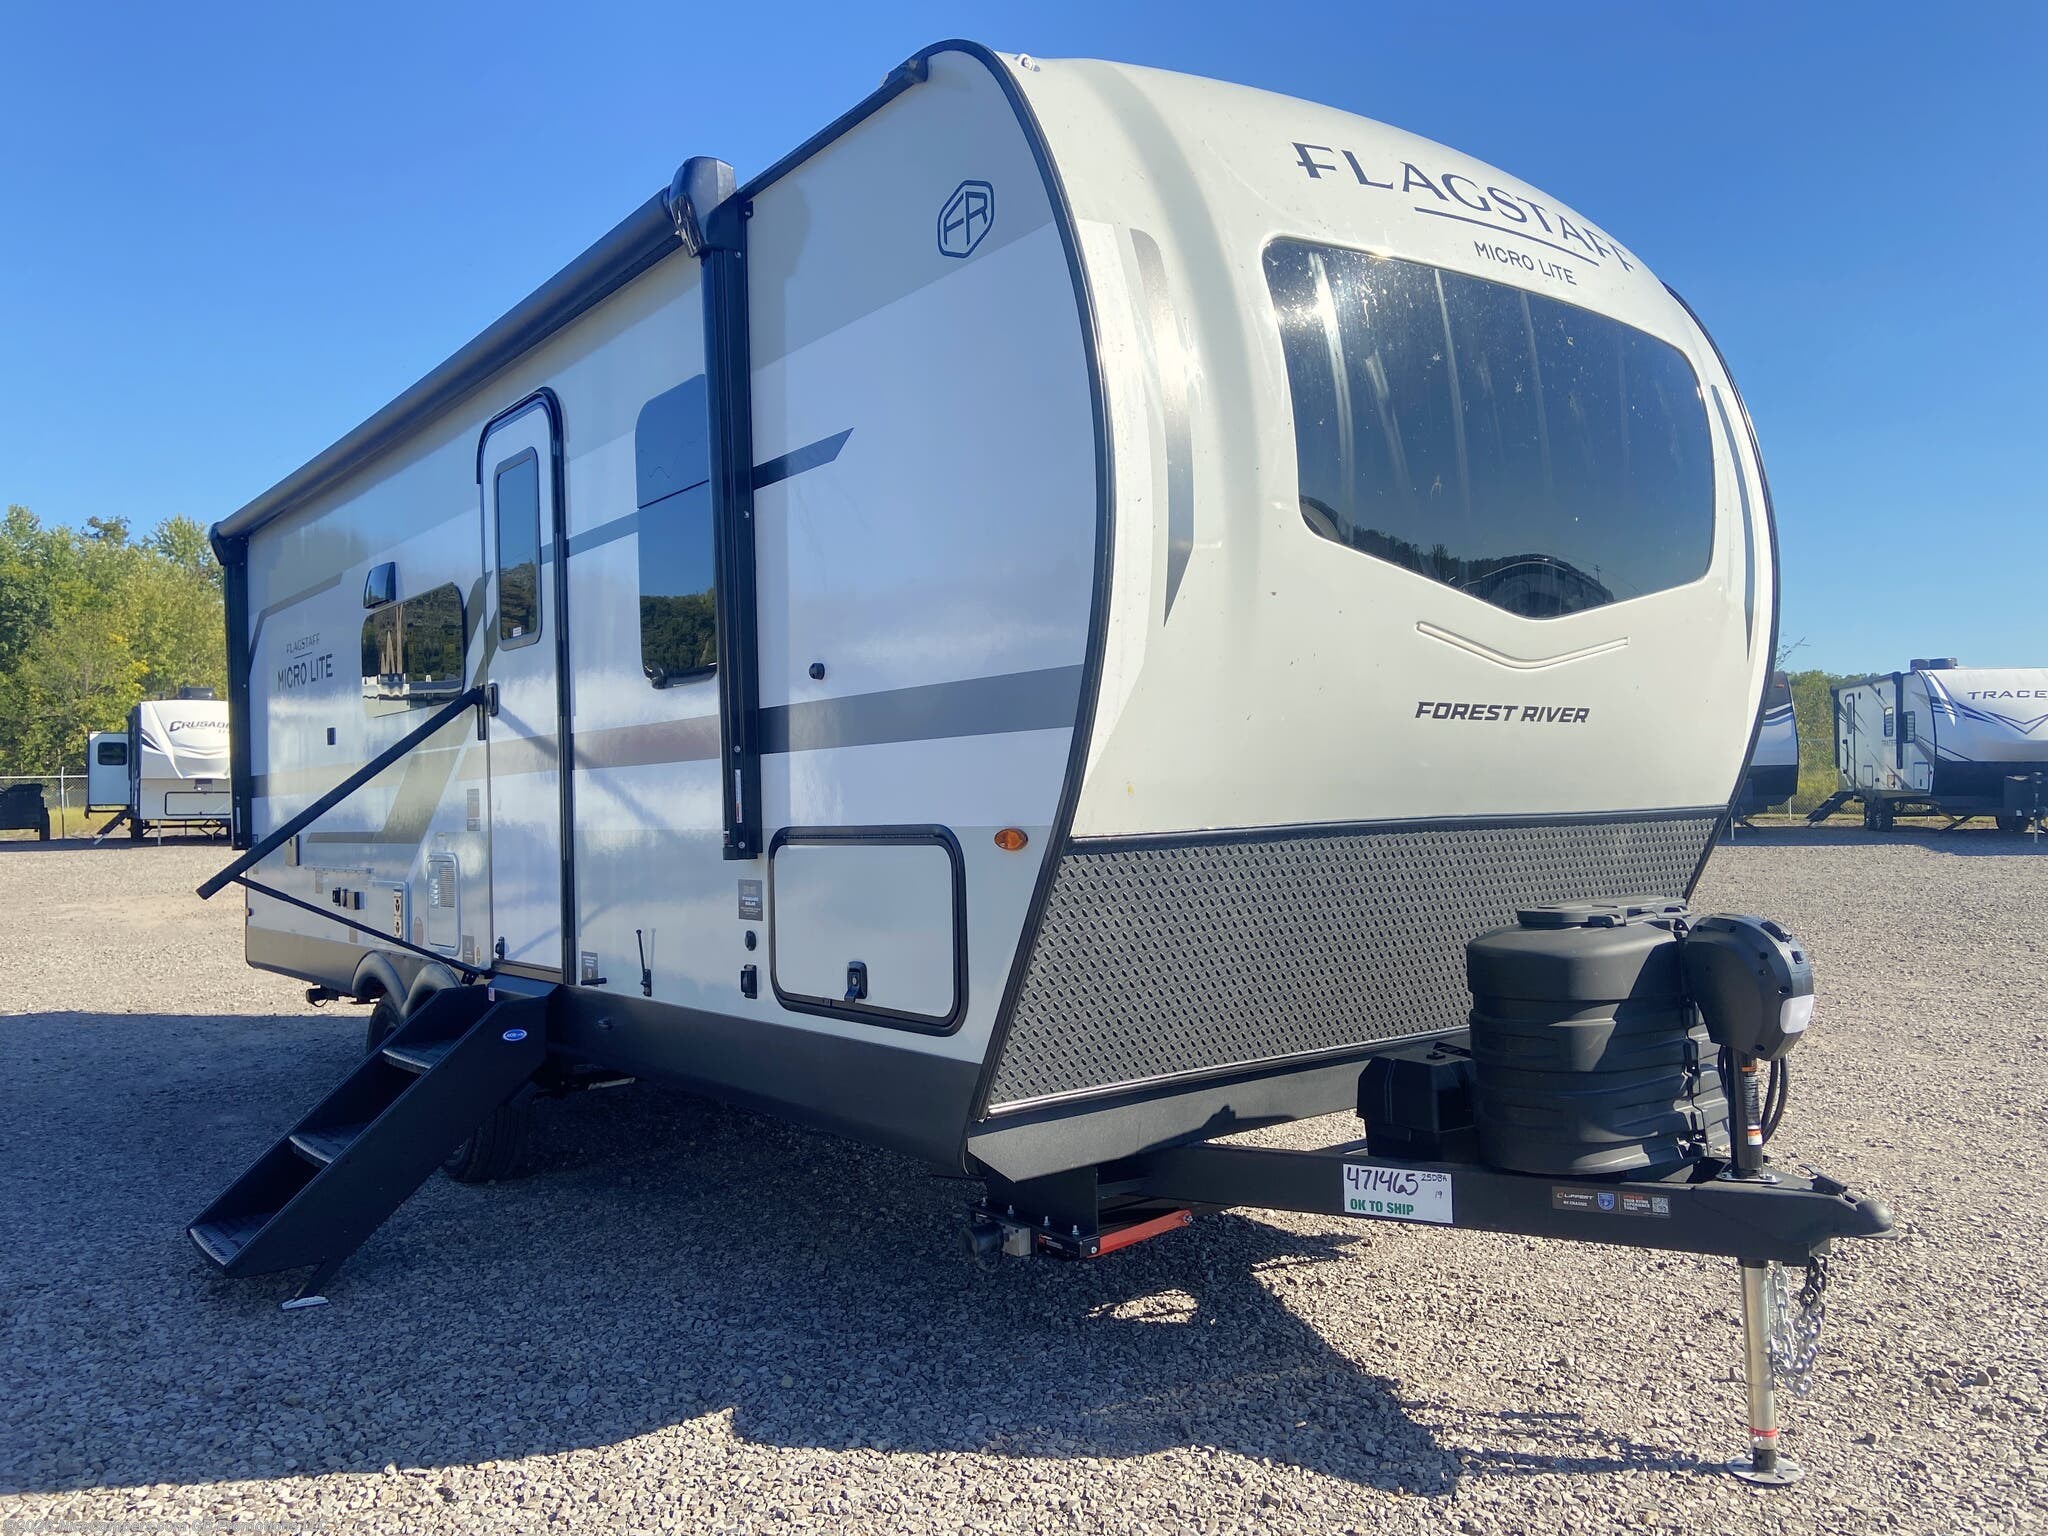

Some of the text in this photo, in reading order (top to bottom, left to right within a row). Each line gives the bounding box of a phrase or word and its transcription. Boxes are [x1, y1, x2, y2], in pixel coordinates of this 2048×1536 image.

[1291, 141, 1635, 273] FLAGSTAFF
[1473, 240, 1577, 286] MICRO LITE
[277, 653, 333, 692] MICRO LITE
[1415, 701, 1590, 724] FOREST RIVER
[1346, 1166, 1419, 1196] 471465
[1350, 1198, 1414, 1215] OK TO SHIP
